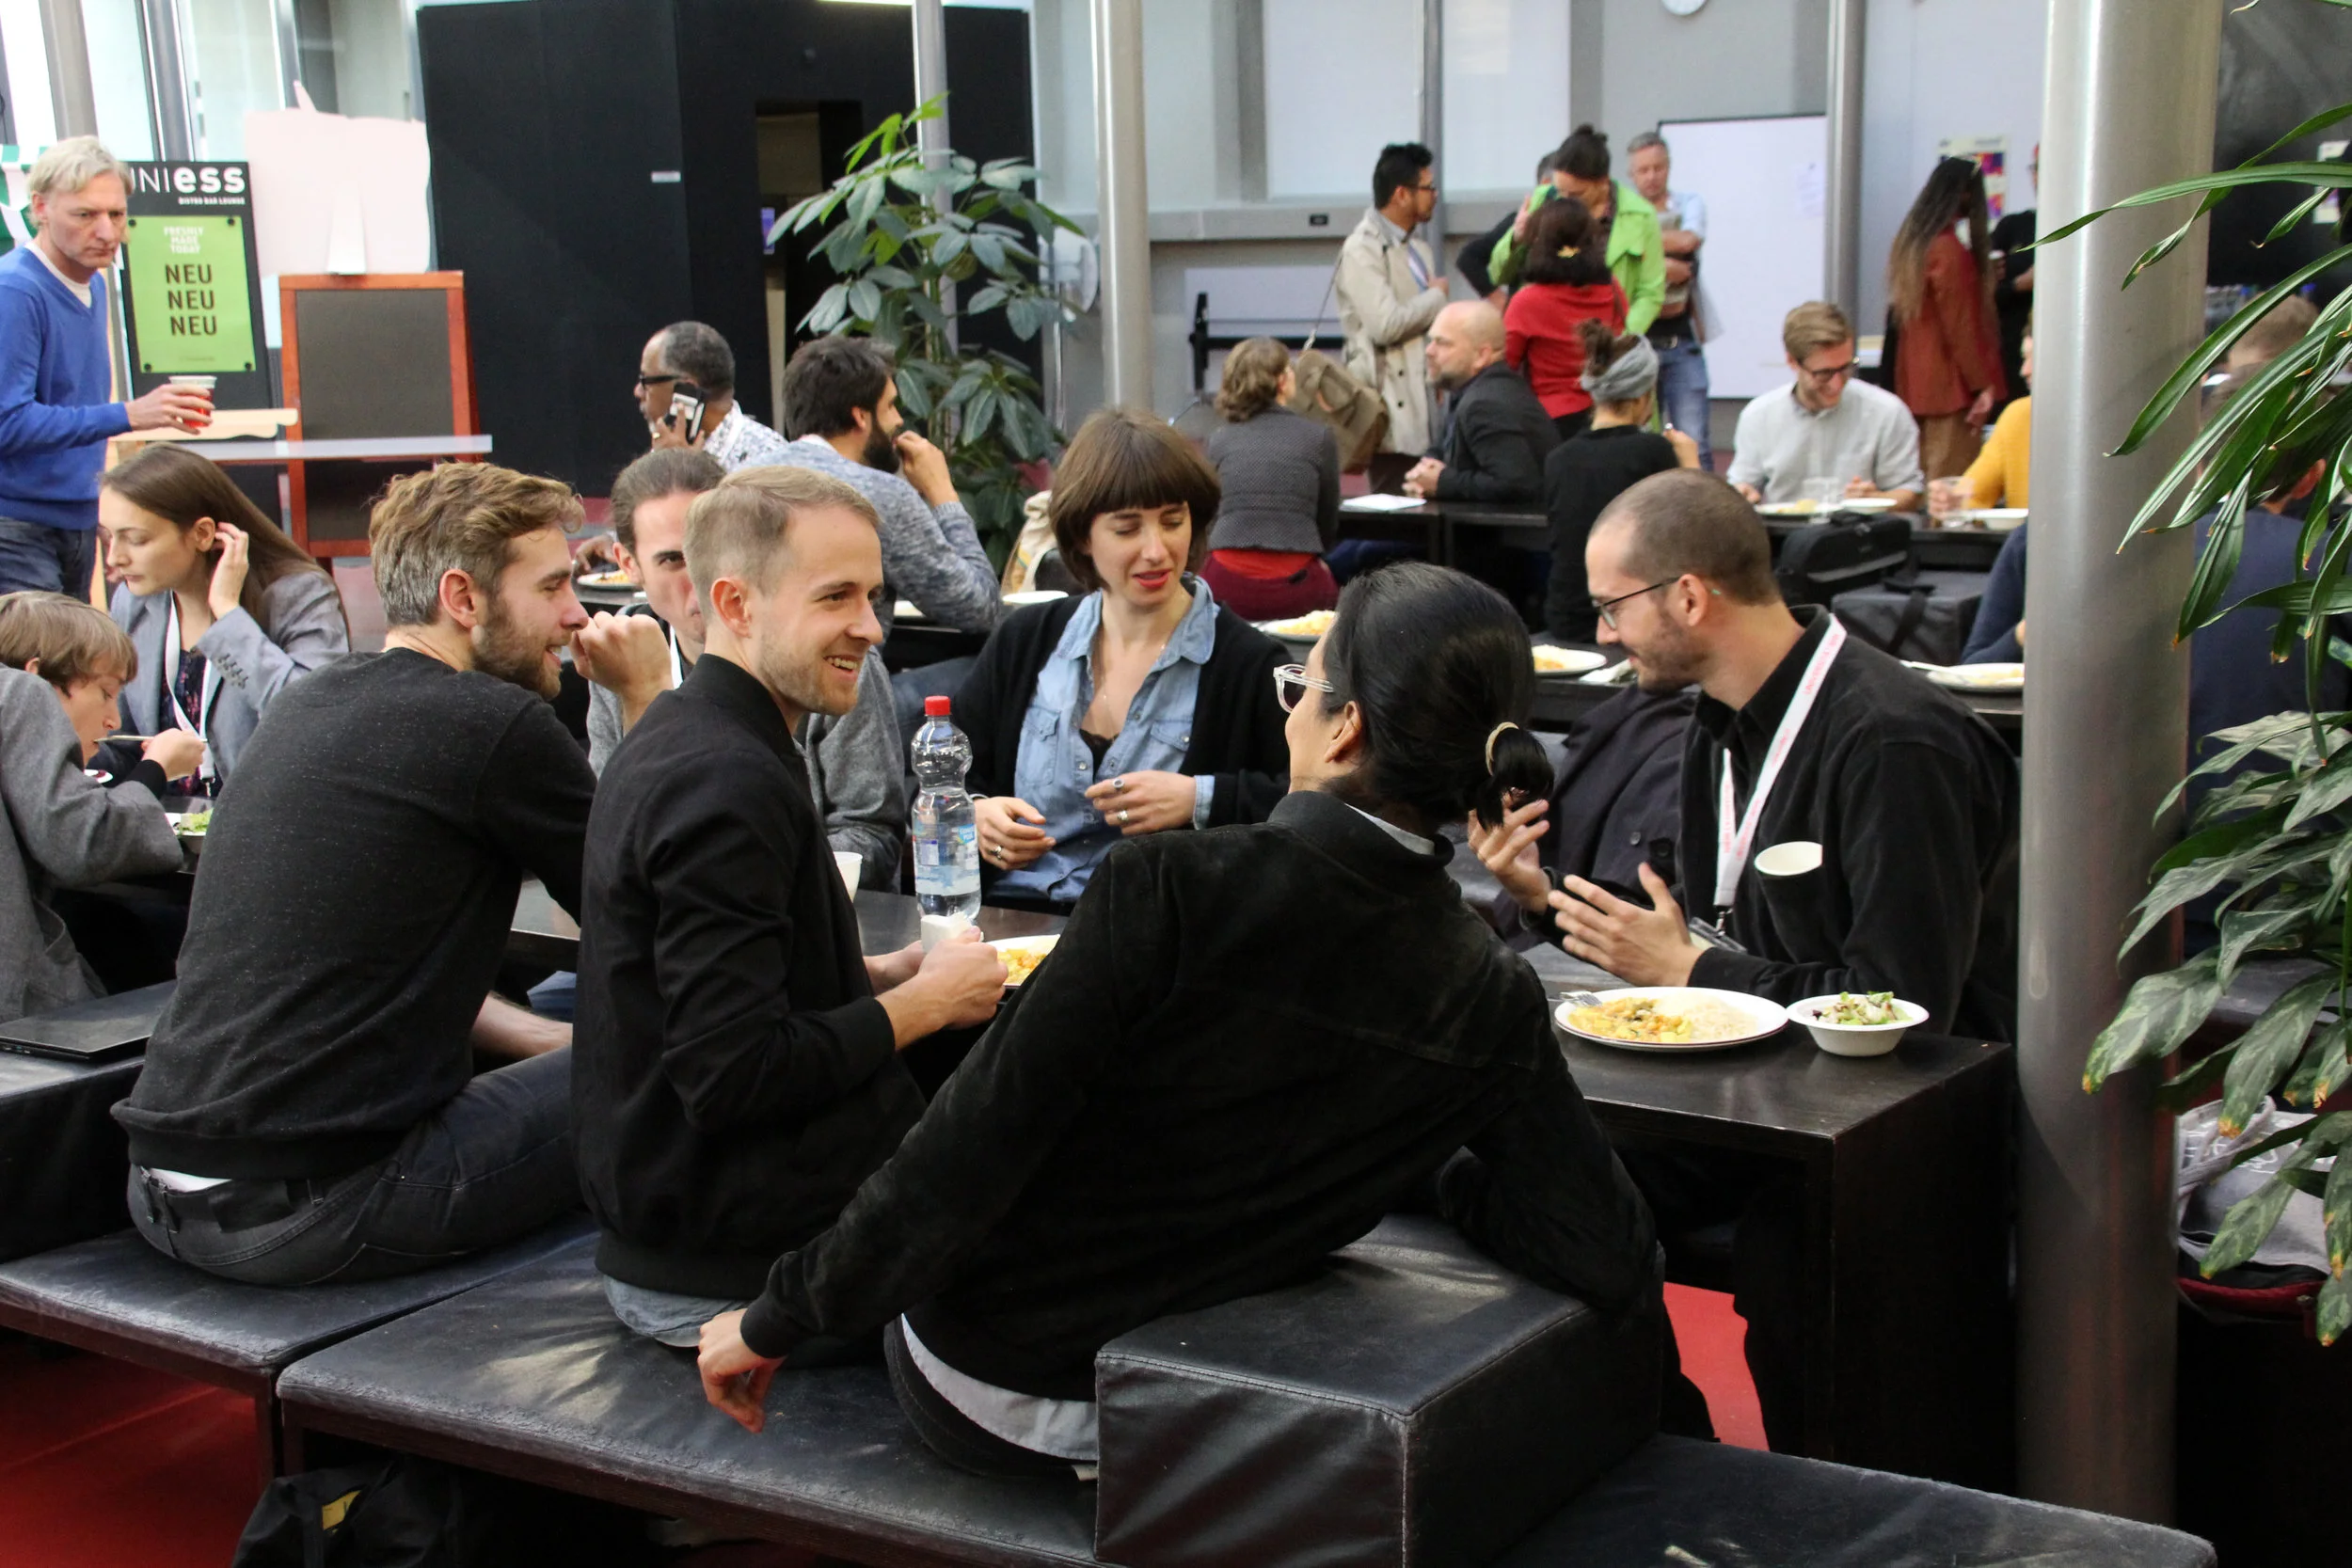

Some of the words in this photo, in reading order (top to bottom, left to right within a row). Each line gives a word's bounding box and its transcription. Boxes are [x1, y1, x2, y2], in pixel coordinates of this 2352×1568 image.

[166, 264, 213, 284] NEU
[168, 290, 215, 309] NEU
[170, 315, 217, 336] NEU
